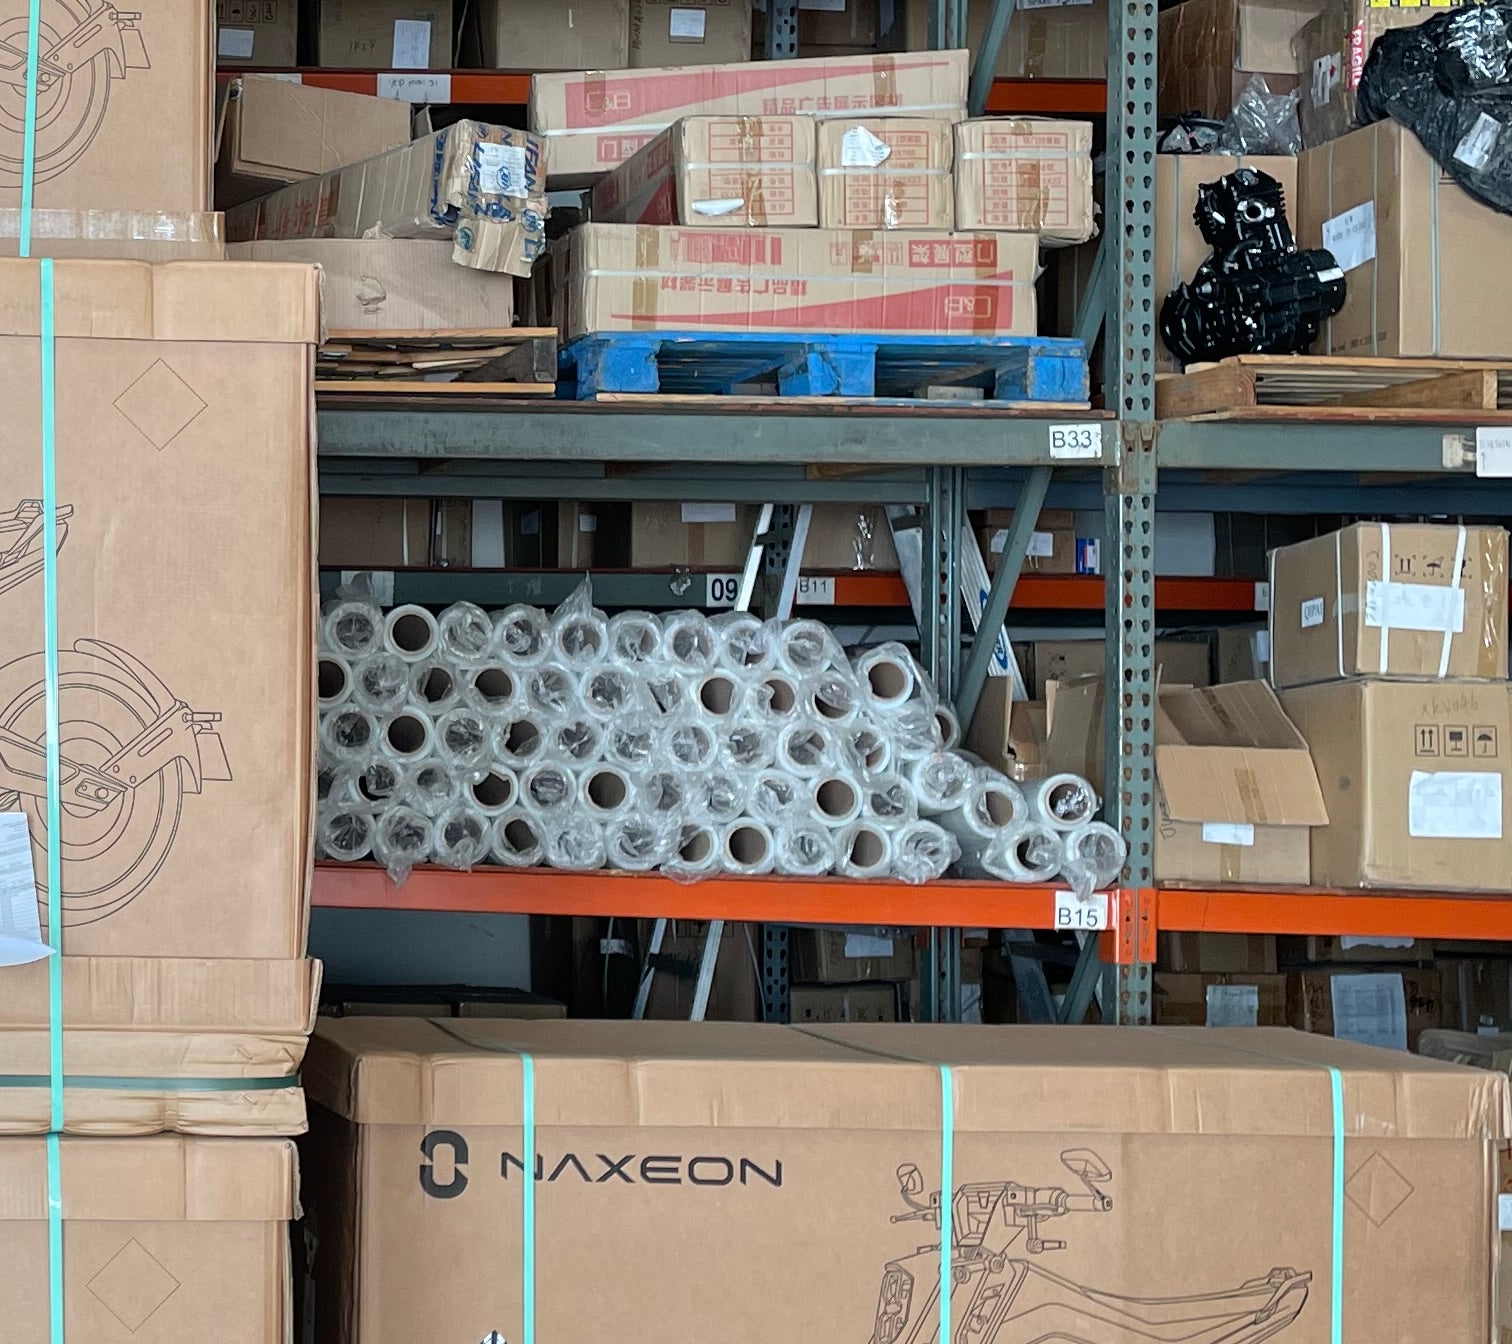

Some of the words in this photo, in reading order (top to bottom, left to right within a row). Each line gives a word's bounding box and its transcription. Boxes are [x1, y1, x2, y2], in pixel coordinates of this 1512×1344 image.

[1052, 430, 1092, 449] B33
[710, 578, 739, 602] 09
[799, 579, 828, 594] B11
[1058, 907, 1098, 927] B15
[501, 1151, 784, 1188] NAXEON
